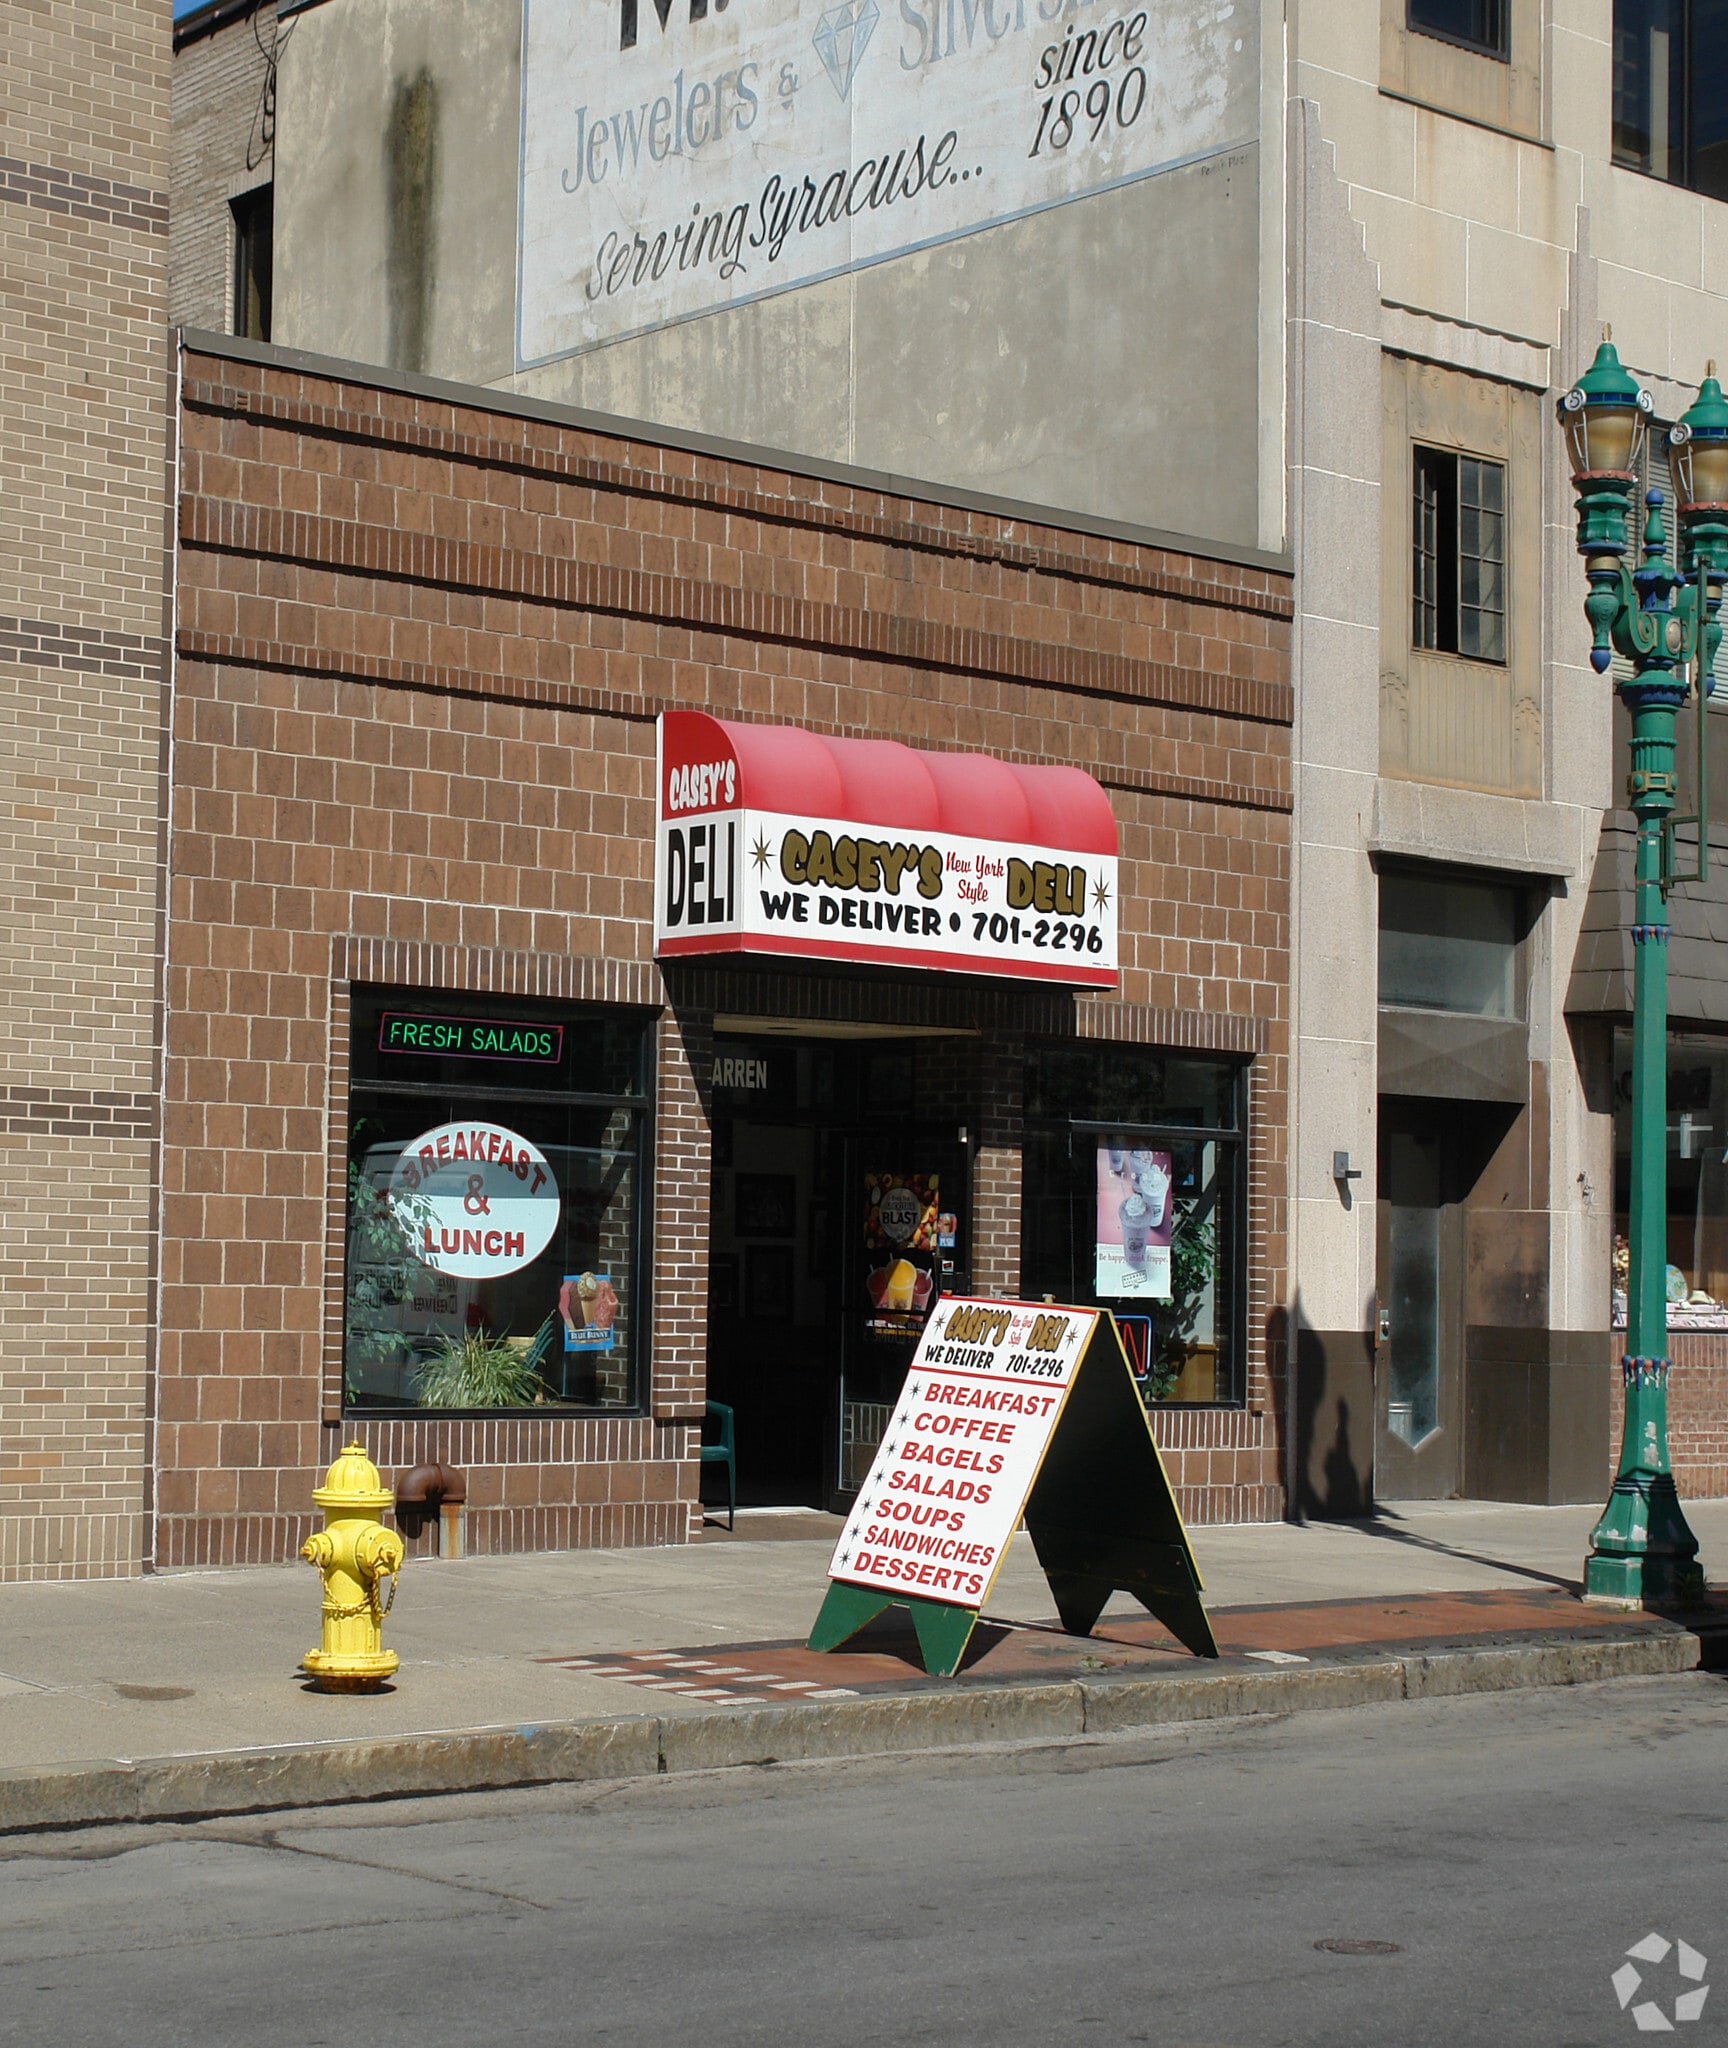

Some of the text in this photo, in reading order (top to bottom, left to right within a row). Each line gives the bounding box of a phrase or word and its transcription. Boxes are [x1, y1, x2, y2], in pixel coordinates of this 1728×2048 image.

[1034, 12, 1147, 89] since
[562, 63, 758, 193] Jewelers
[778, 62, 799, 99] &
[1028, 66, 1146, 158] 1890
[586, 130, 982, 300] Serving Syracuse...
[669, 758, 736, 811] CASEY'S
[667, 821, 735, 927] DELI
[780, 829, 943, 899] CASEY'S
[945, 851, 1005, 878] New York
[957, 878, 988, 904] Style
[1006, 857, 1086, 917] DELI
[759, 890, 1103, 954] WE DELIVER 701-2296
[390, 1022, 551, 1055] FRESH SALADS
[401, 1130, 547, 1195] BREAKFAST
[463, 1173, 490, 1216] &
[882, 1211, 918, 1226] BLAST
[424, 1227, 525, 1257] LUNCH
[944, 1305, 1012, 1347] CASEY'S
[1026, 1313, 1070, 1352] DELI
[925, 1345, 1064, 1378] WE DELIVER 701-2296
[924, 1382, 1056, 1417] BREAKFAST
[914, 1412, 1016, 1444] COFFEE
[900, 1441, 1005, 1474] BAGELS
[888, 1470, 993, 1504] SALADS
[875, 1499, 966, 1532] SOUPS
[864, 1524, 995, 1566] SANDWICHES
[853, 1552, 984, 1595] DESSERTS
